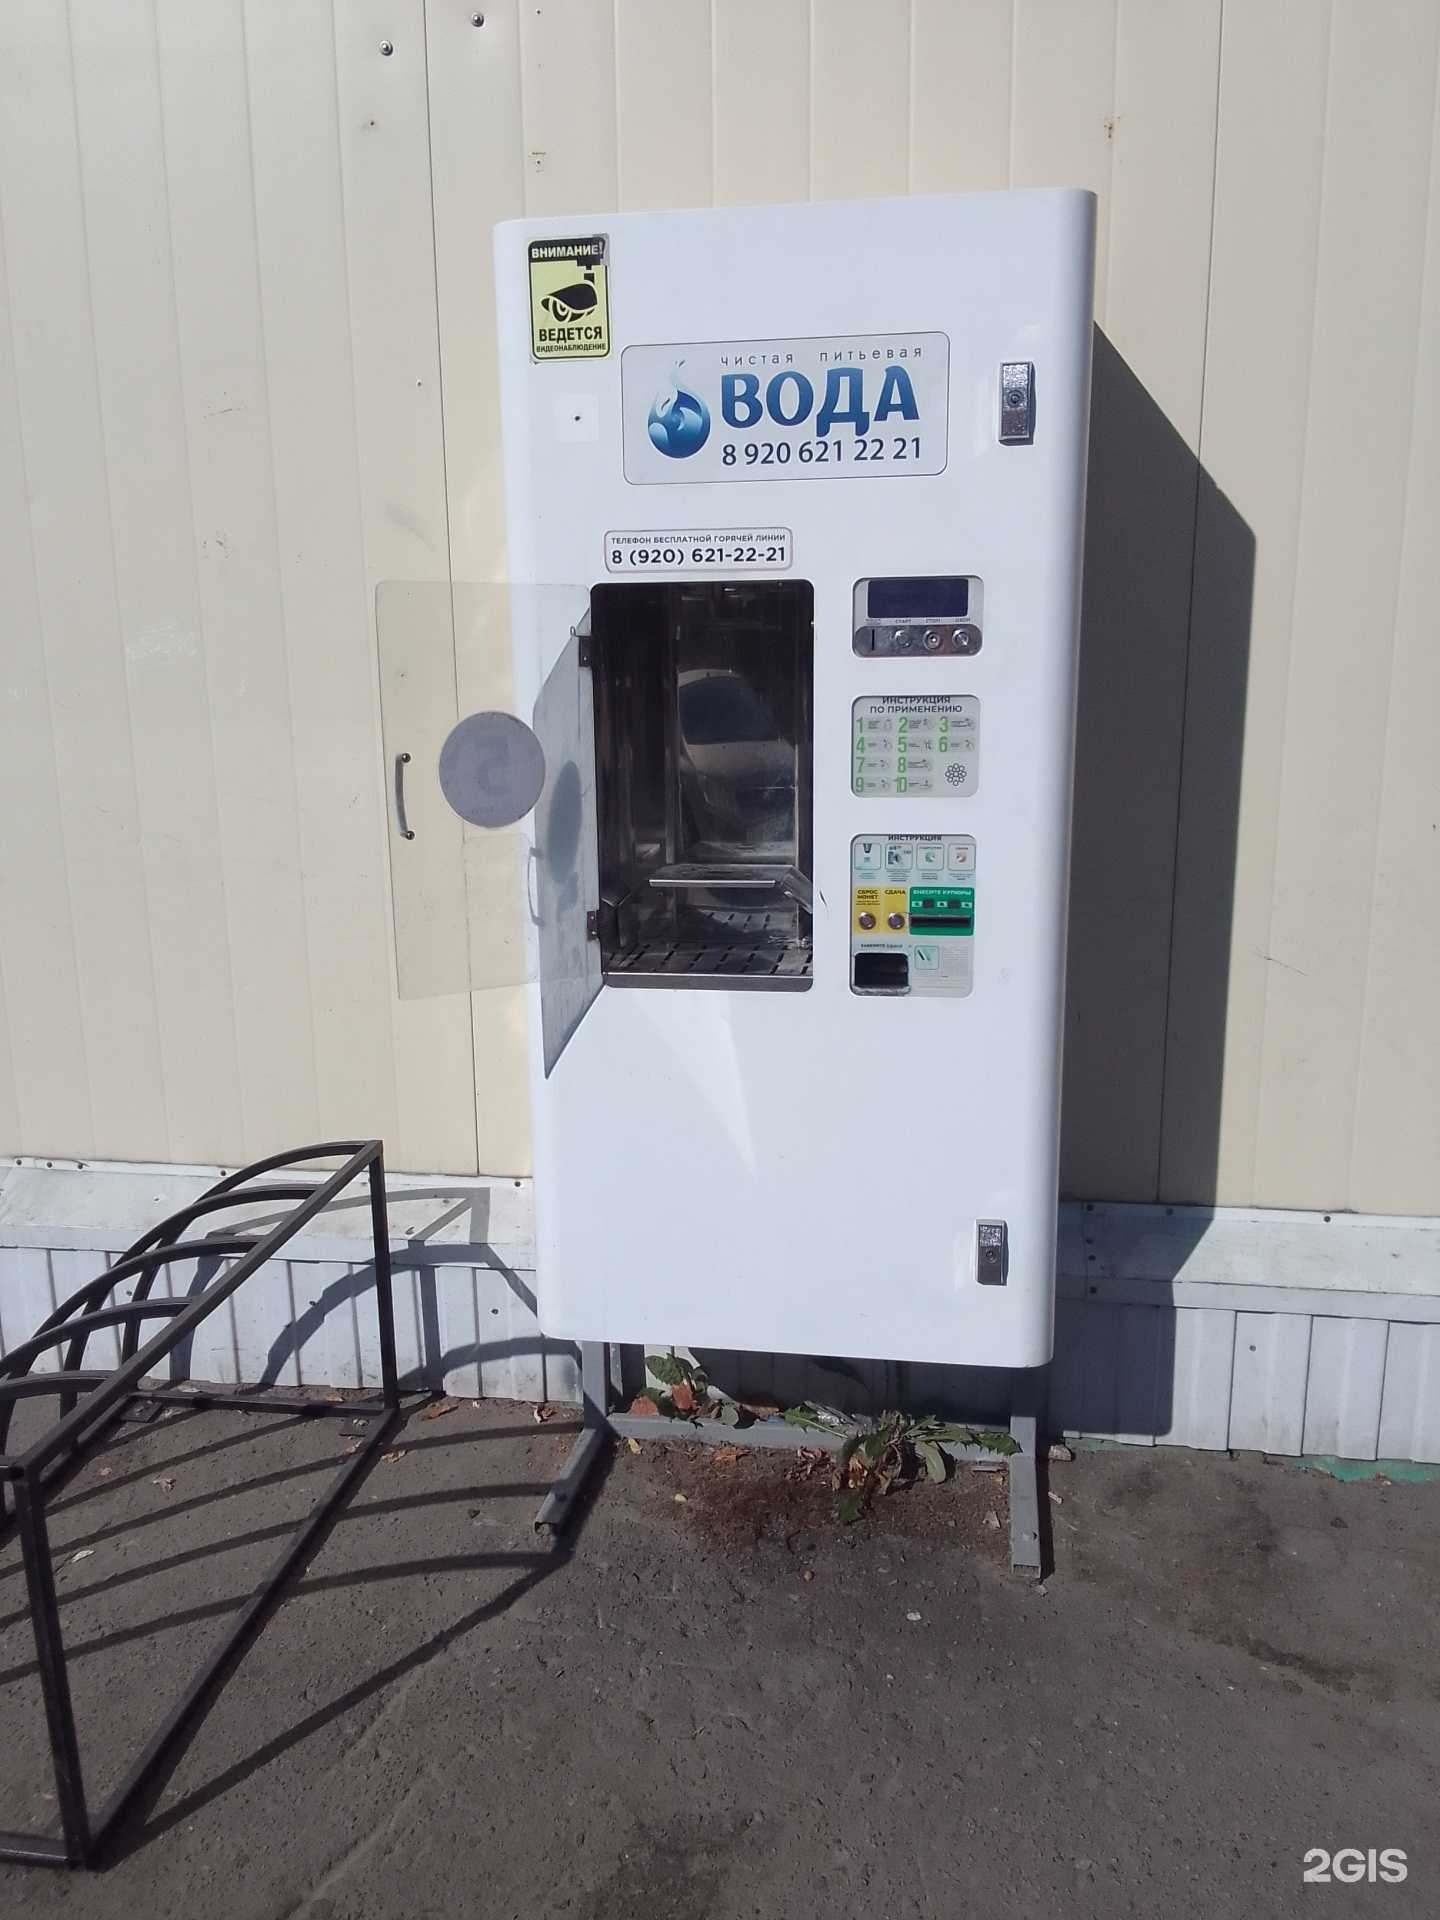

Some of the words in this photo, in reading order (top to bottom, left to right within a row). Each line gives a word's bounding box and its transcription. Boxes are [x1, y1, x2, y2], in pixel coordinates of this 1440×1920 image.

[531, 242, 604, 259] ВНИМАНИЕ!
[539, 326, 602, 344] ВЕДЕТСЯ
[536, 343, 606, 353] ВИДЕОНАБЛЮДЕНИЕ
[721, 353, 793, 367] чистая
[819, 347, 922, 362] питьевая
[720, 365, 920, 438] ВОДА
[722, 444, 736, 466] 8
[744, 442, 791, 465] 920
[798, 440, 842, 463] 621
[853, 438, 884, 461] 22
[893, 437, 920, 460] 21
[612, 537, 651, 545] ТЕЛЕФОН
[653, 534, 712, 544] БЕСПЛАТНОЙ
[714, 533, 753, 543] ГОРЯЧЕЙ
[755, 534, 785, 542] ЛИНИИ
[611, 550, 622, 564] 8
[629, 548, 684, 566] (920)
[691, 546, 785, 563] 621-22-21
[882, 696, 951, 705] ИНСТРУКЦИЯ
[870, 706, 885, 714] ПО
[887, 705, 963, 713] ПРИМЕНЕНИЮ
[856, 716, 864, 734] 1
[898, 716, 908, 733] 2
[939, 716, 949, 733] 3
[856, 736, 865, 753] 4
[898, 736, 907, 753] 5
[939, 736, 948, 753] 6
[856, 756, 865, 773] 7
[898, 757, 906, 773] 8
[855, 777, 865, 793] 9
[895, 776, 907, 793] 10
